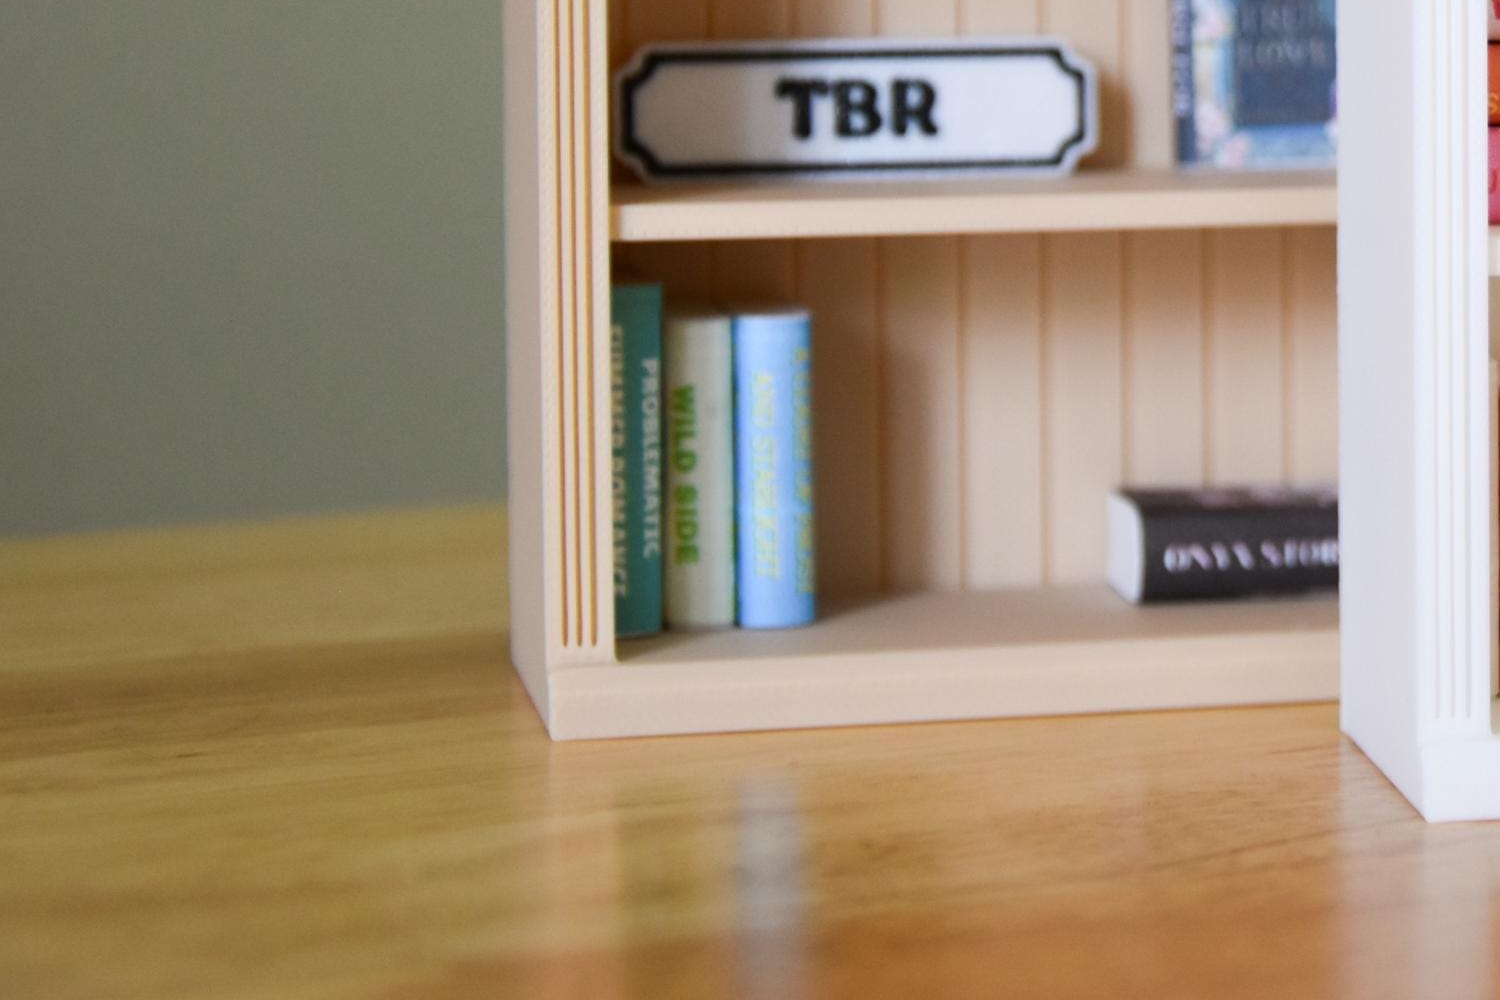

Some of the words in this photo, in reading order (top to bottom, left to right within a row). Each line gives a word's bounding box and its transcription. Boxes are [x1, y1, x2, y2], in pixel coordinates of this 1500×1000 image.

[775, 76, 938, 140] TBR
[641, 357, 661, 560] PROBLEMATIC
[672, 383, 696, 474] WILD
[674, 484, 699, 565] SIDE
[1163, 542, 1254, 574] ONYX
[1260, 537, 1338, 570] STOR
